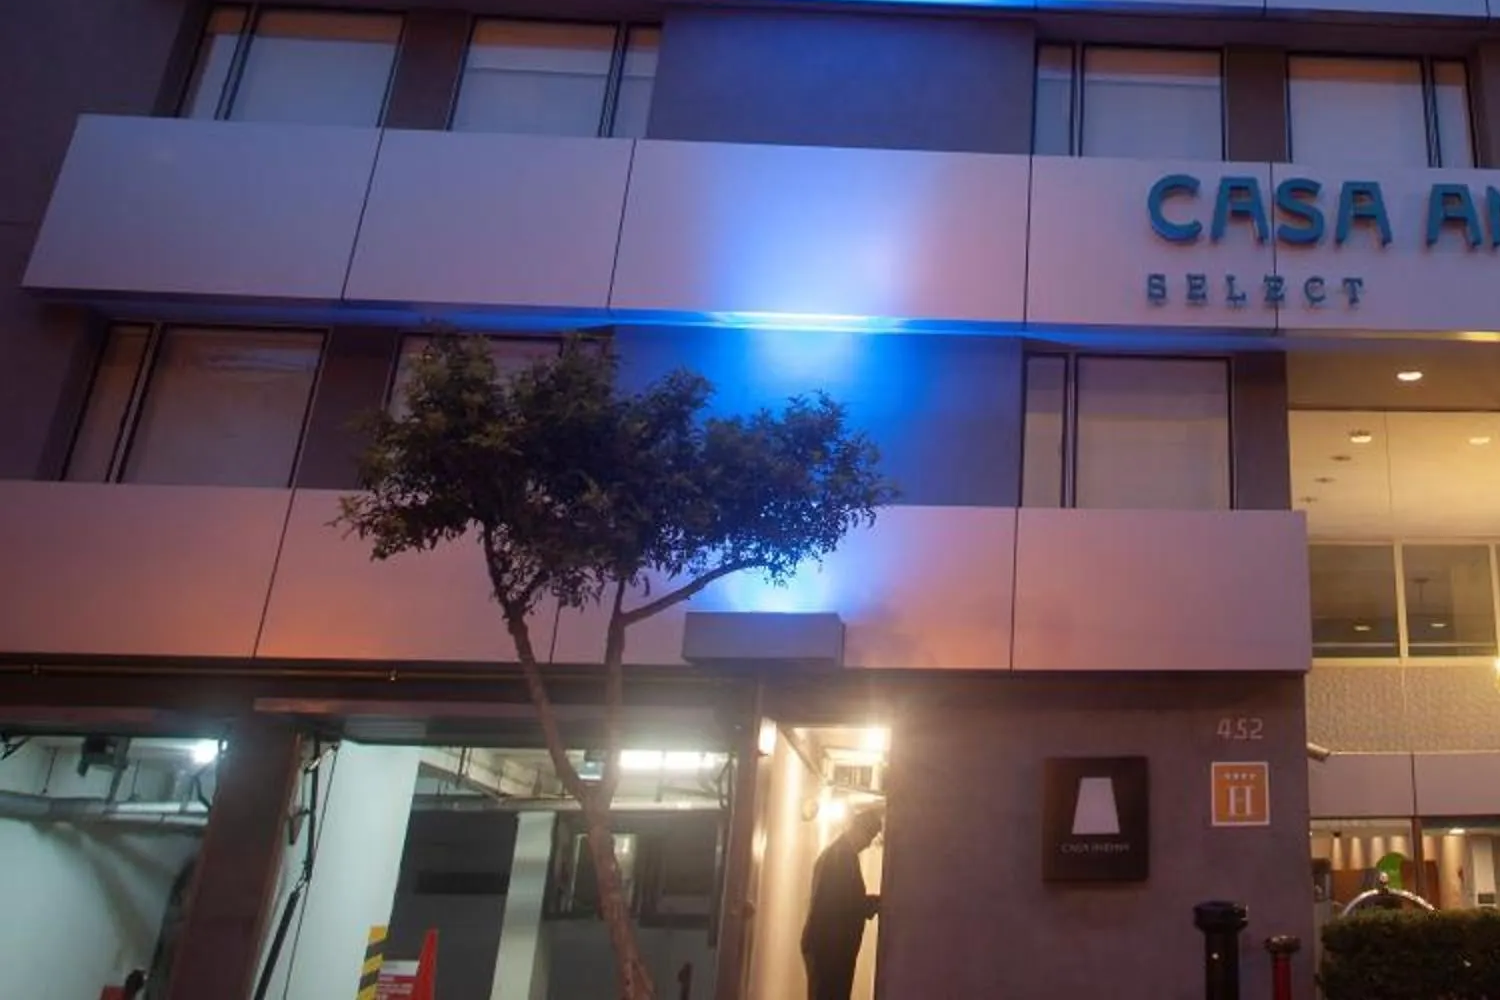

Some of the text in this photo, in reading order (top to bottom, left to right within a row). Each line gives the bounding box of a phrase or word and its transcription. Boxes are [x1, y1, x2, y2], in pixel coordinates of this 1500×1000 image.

[1147, 174, 1392, 246] CASA
[1147, 273, 1363, 304] SELECT
[1216, 718, 1263, 740] 452
